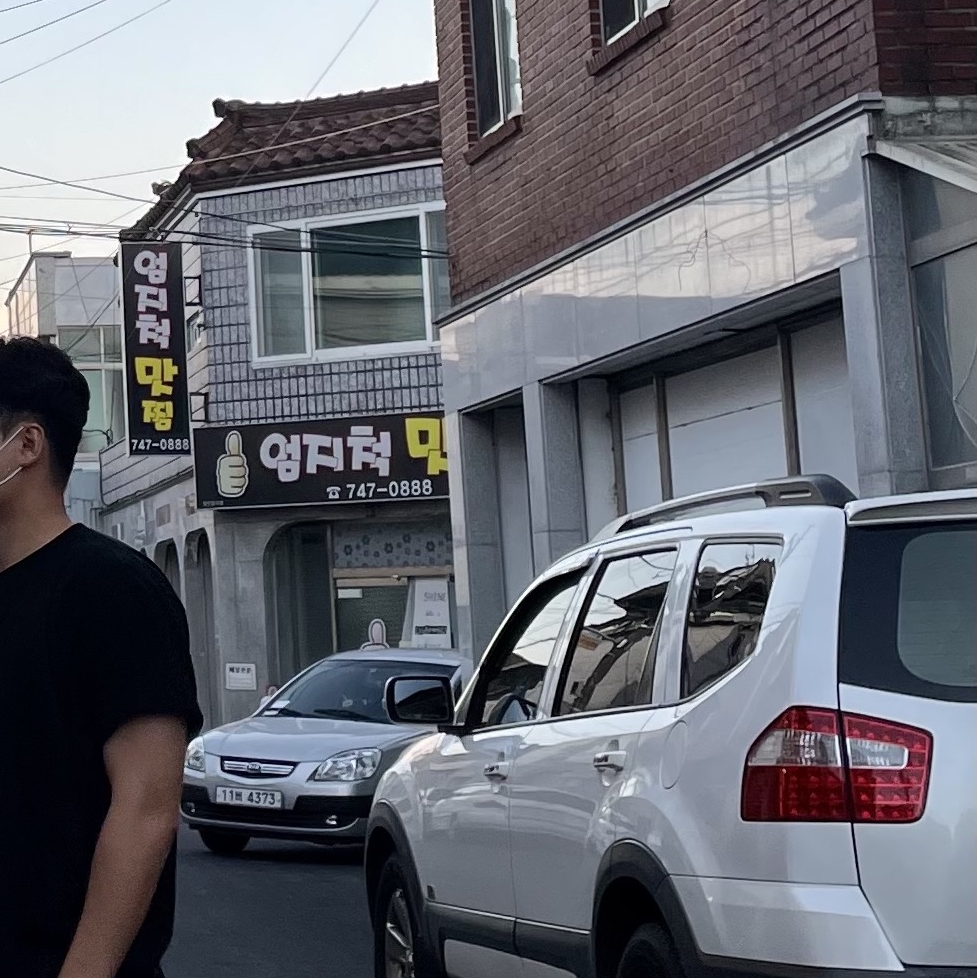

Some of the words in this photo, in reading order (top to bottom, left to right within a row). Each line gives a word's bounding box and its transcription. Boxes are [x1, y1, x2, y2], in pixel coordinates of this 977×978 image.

[133, 250, 171, 349] 엄지척
[131, 438, 189, 451] 747-0888
[259, 425, 391, 482] 엄지척
[346, 479, 433, 499] 747-0888
[247, 791, 276, 806] 4373
